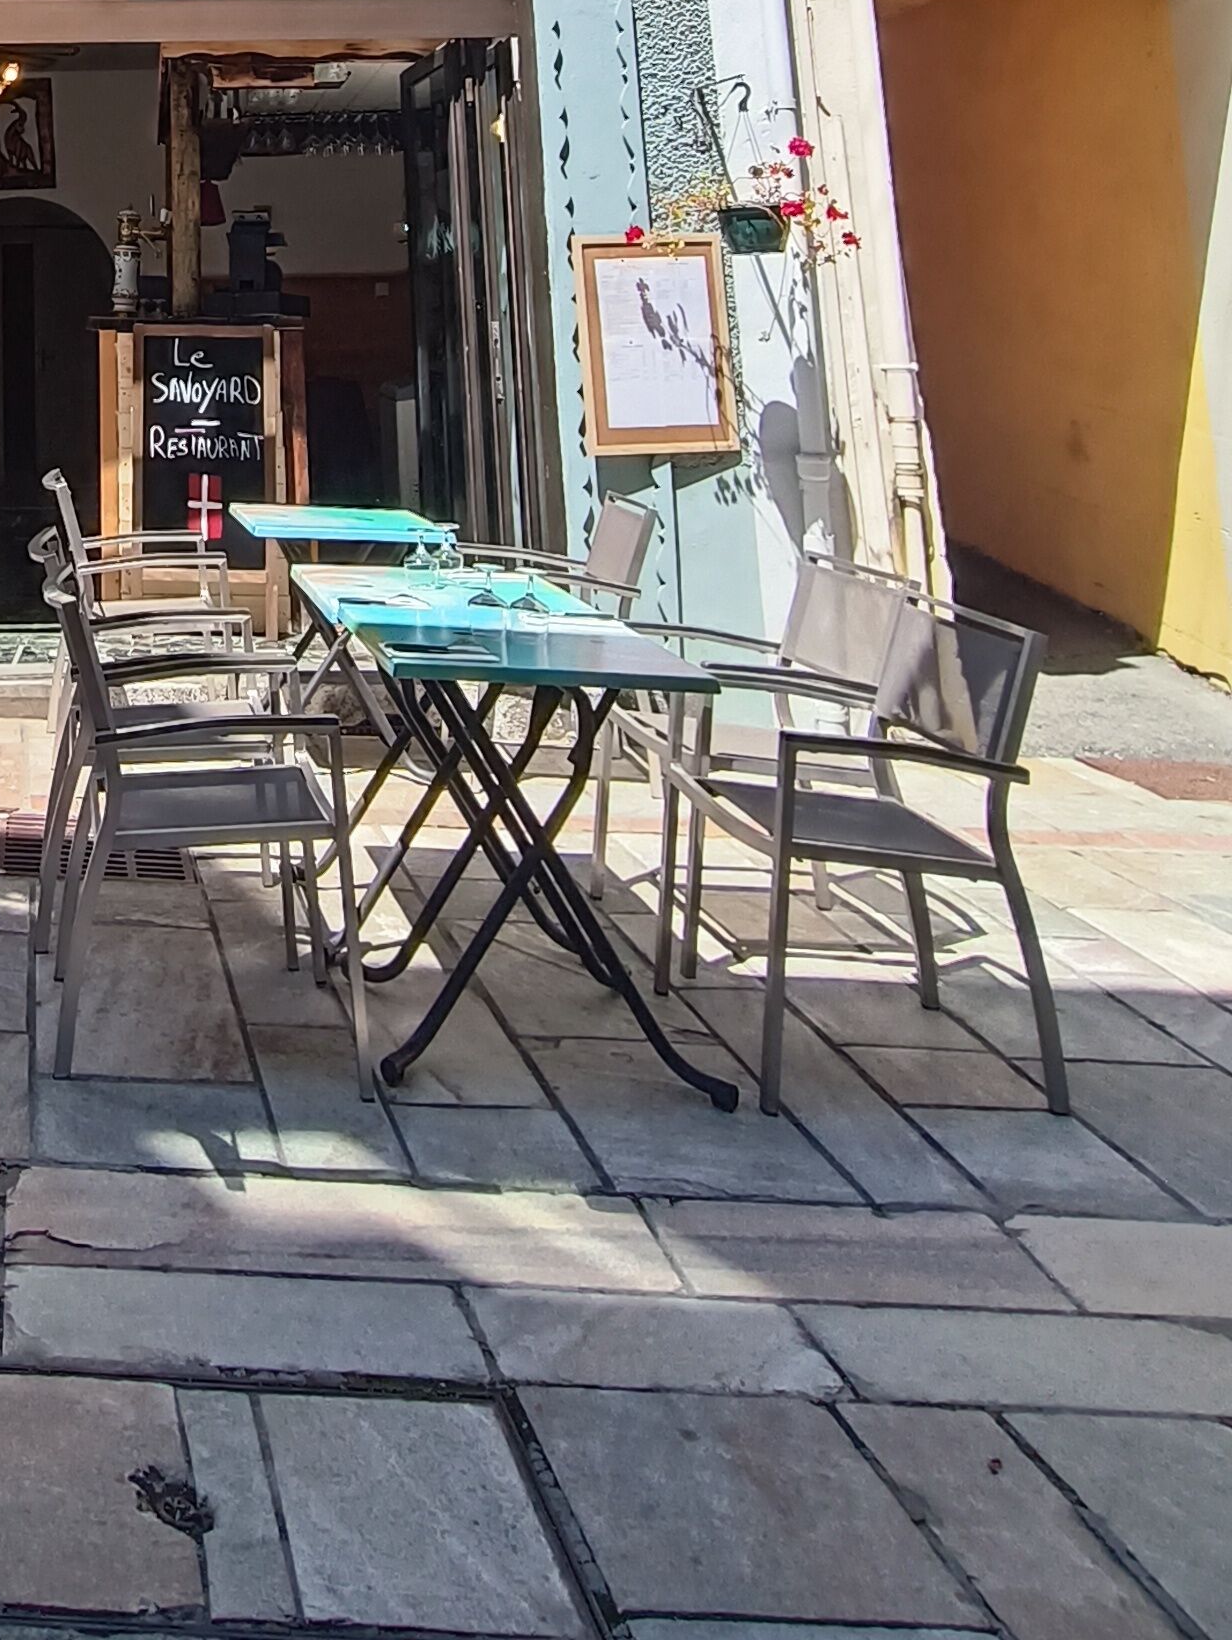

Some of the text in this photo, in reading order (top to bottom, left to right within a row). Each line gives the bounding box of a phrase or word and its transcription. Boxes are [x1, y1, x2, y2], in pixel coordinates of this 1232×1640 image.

[172, 337, 214, 368] Le
[151, 371, 262, 414] SAVOYARD
[149, 424, 264, 461] RESTAURANT
